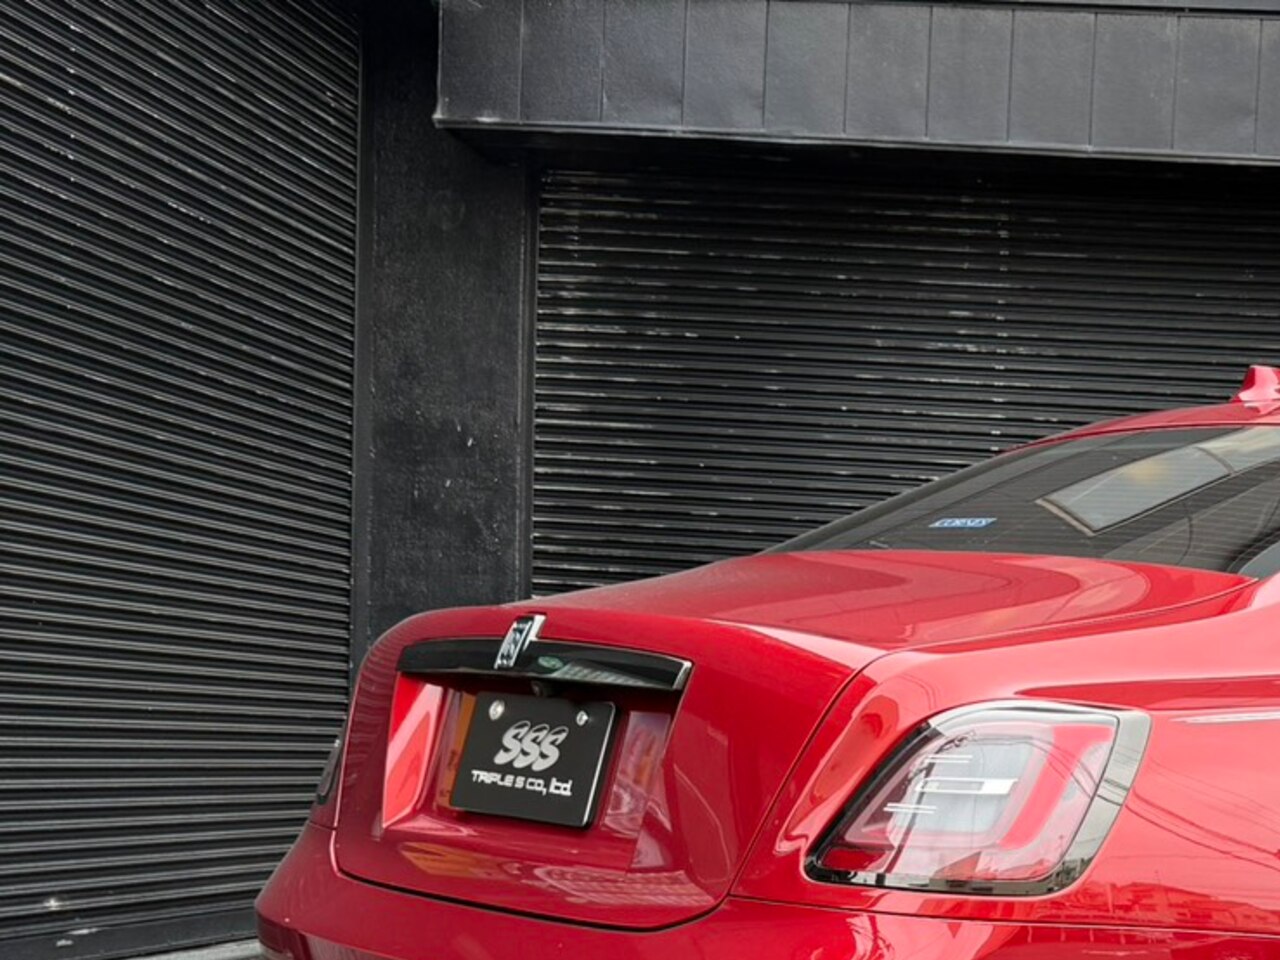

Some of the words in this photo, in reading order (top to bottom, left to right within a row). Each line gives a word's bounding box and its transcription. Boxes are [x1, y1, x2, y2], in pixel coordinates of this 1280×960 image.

[493, 720, 570, 772] SSS
[471, 769, 515, 787] TRIPLE
[514, 775, 526, 789] S
